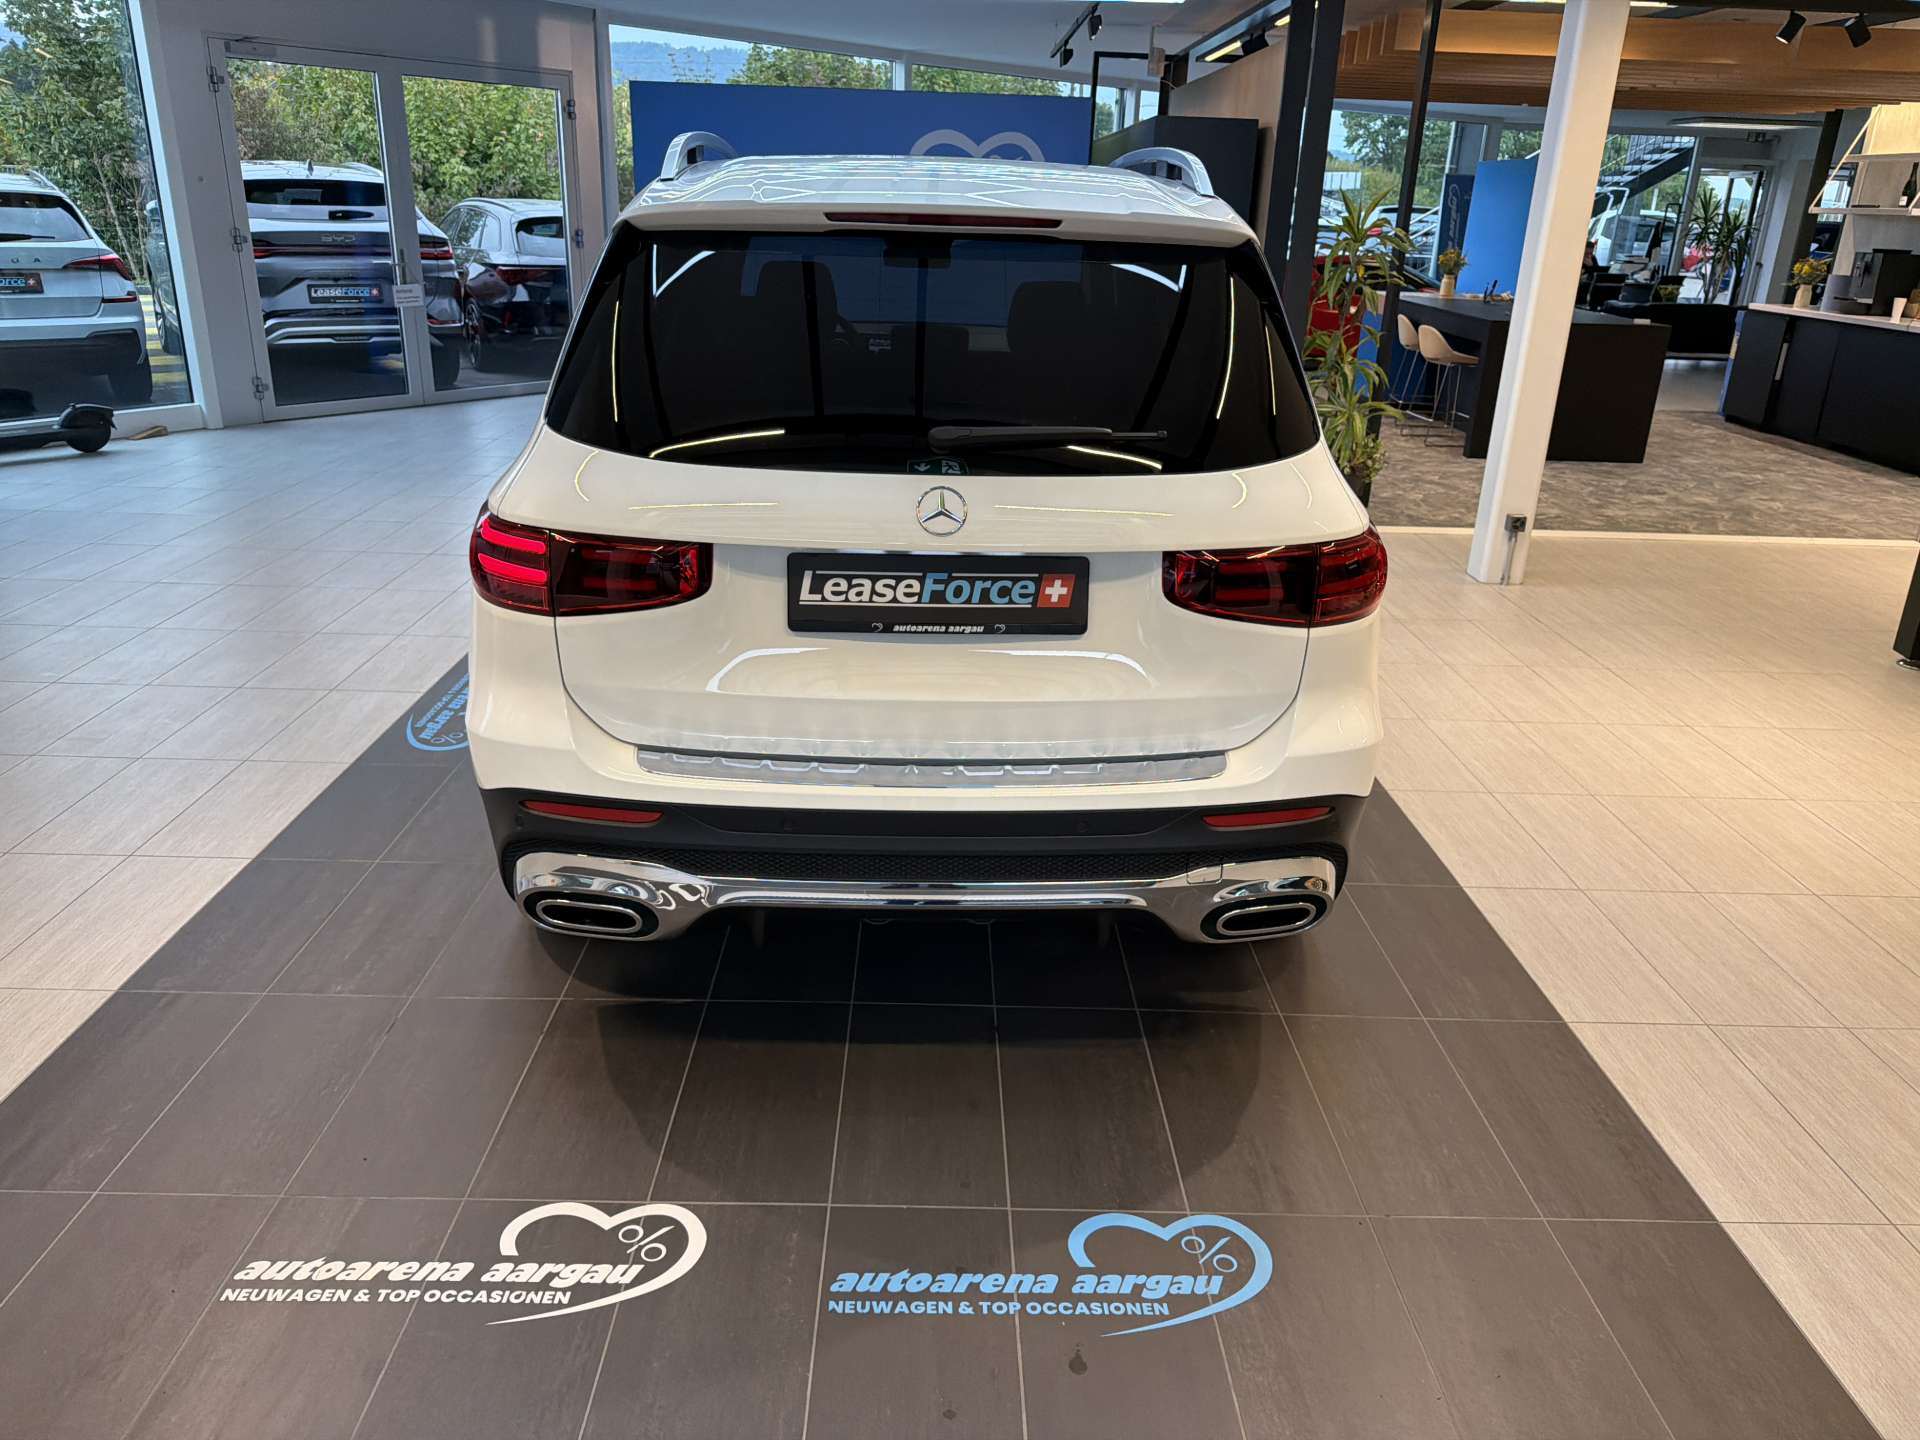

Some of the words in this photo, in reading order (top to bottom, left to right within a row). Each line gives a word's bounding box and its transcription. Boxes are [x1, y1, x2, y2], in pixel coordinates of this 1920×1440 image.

[311, 286, 370, 297] LeaseForce
[799, 570, 1036, 604] LeaseForce
[892, 623, 946, 632] autoarena
[947, 625, 985, 634] aargau
[233, 1256, 475, 1282] autoarena
[480, 1261, 646, 1288] aargau
[829, 1267, 1059, 1294] autoarena
[1071, 1273, 1224, 1300] aargau
[219, 1288, 352, 1303] NEUWAGEN
[353, 1289, 372, 1303] &
[377, 1289, 422, 1303] TOP
[423, 1289, 572, 1305] OCCASIONEN
[828, 1300, 954, 1315] NEUWAGEN
[958, 1301, 975, 1315] &
[978, 1301, 1022, 1315] TOP
[1025, 1302, 1170, 1316] OCCASIONEN
